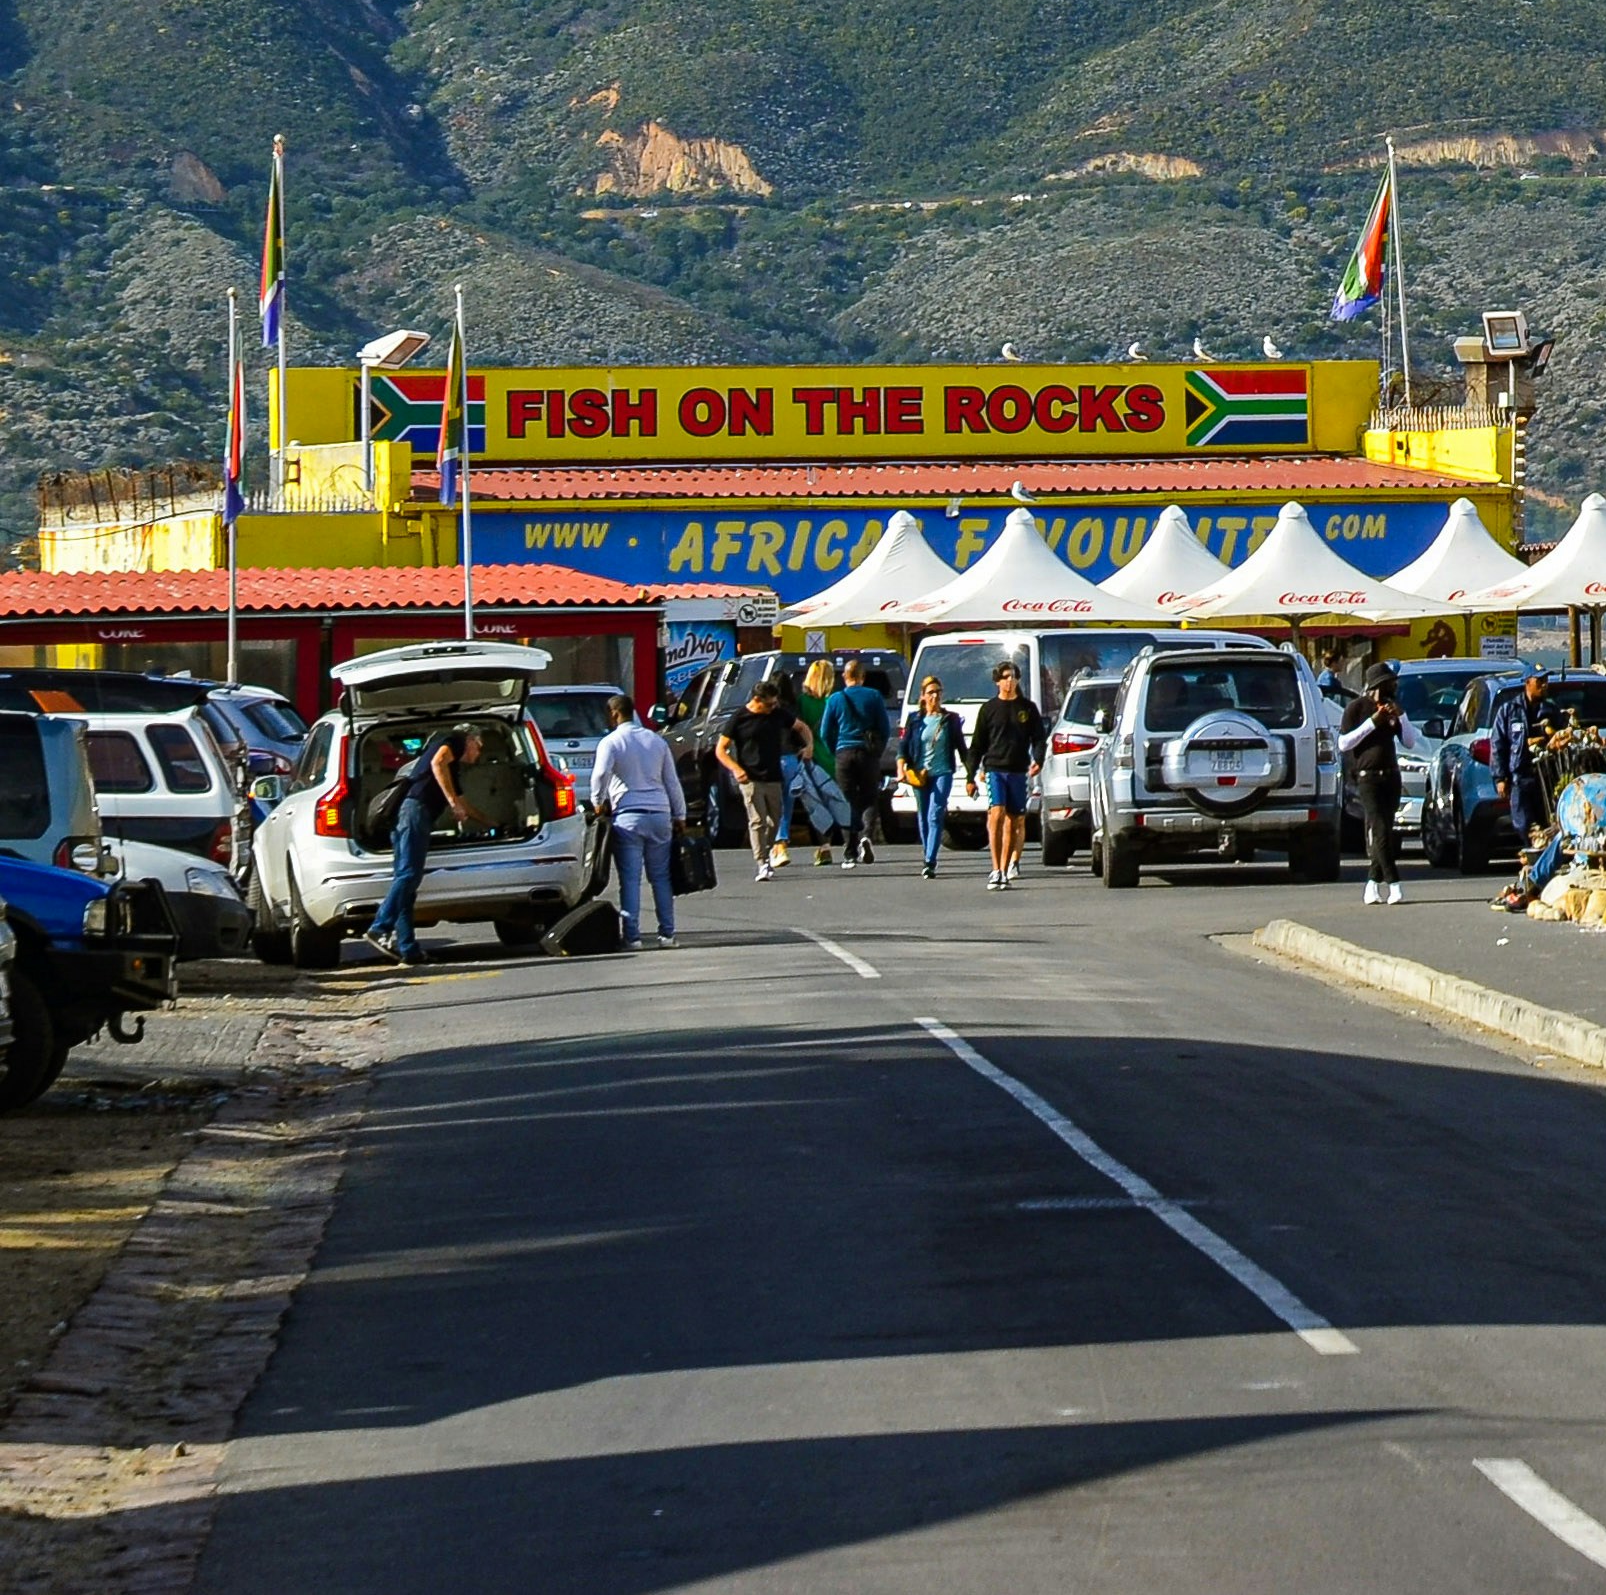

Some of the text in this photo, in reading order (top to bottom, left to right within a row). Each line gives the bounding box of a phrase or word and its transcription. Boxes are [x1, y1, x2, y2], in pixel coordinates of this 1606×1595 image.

[507, 384, 1166, 438] FISH ON THE ROCKS
[1325, 513, 1387, 540] COM
